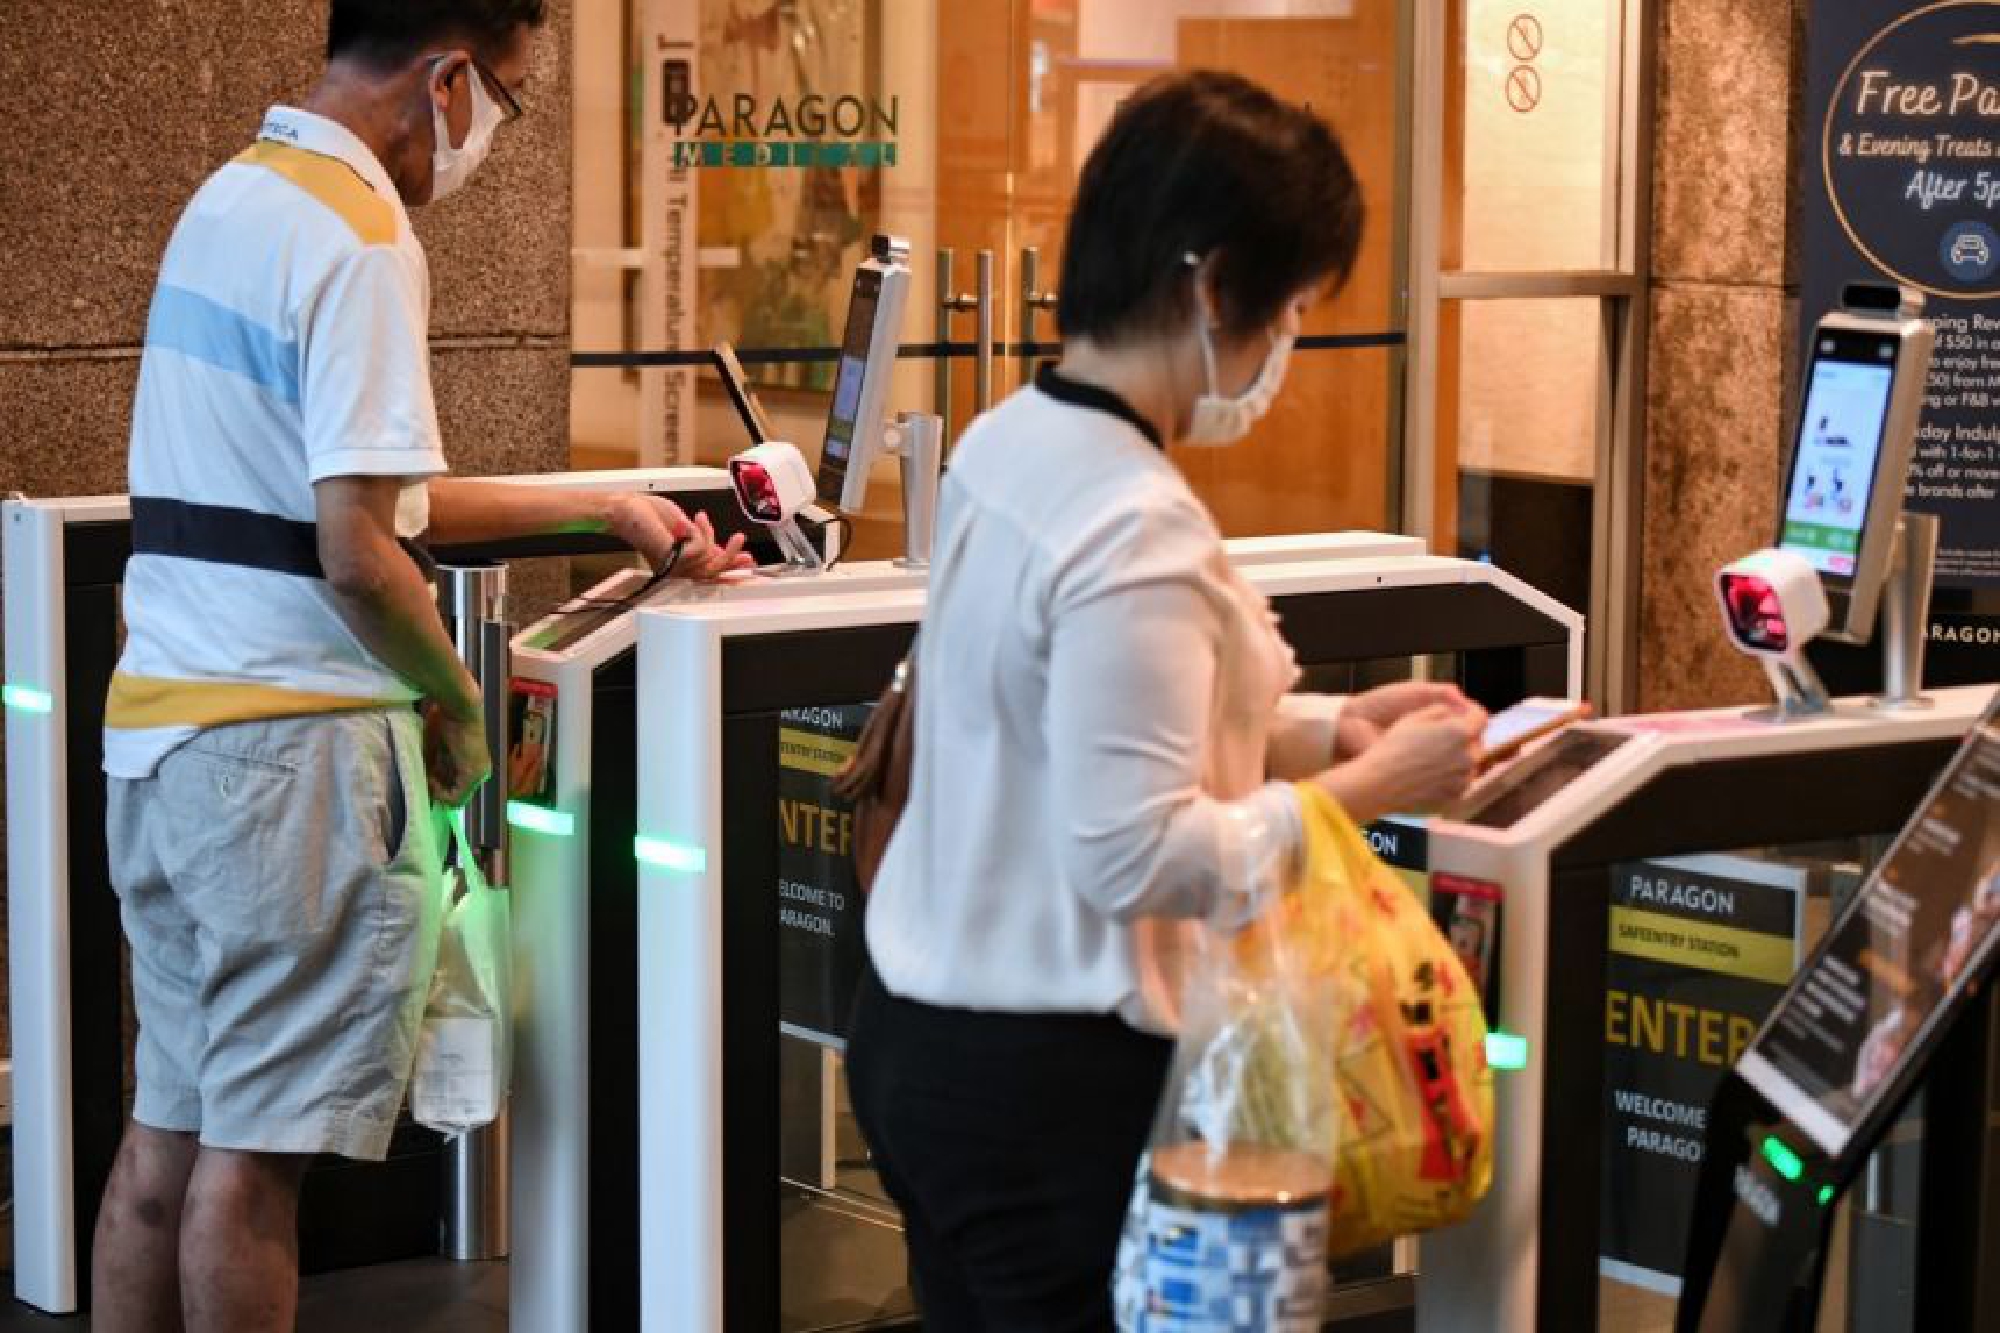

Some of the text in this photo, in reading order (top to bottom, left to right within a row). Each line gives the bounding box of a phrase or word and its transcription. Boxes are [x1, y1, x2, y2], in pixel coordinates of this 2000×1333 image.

[1857, 70, 1942, 114] Free
[674, 94, 899, 136] PARAGON
[1838, 132, 1991, 164] & Evening Treats
[1905, 169, 1967, 210] After
[1629, 874, 1736, 915] PARAGON
[1614, 1090, 1707, 1129] WELCOME
